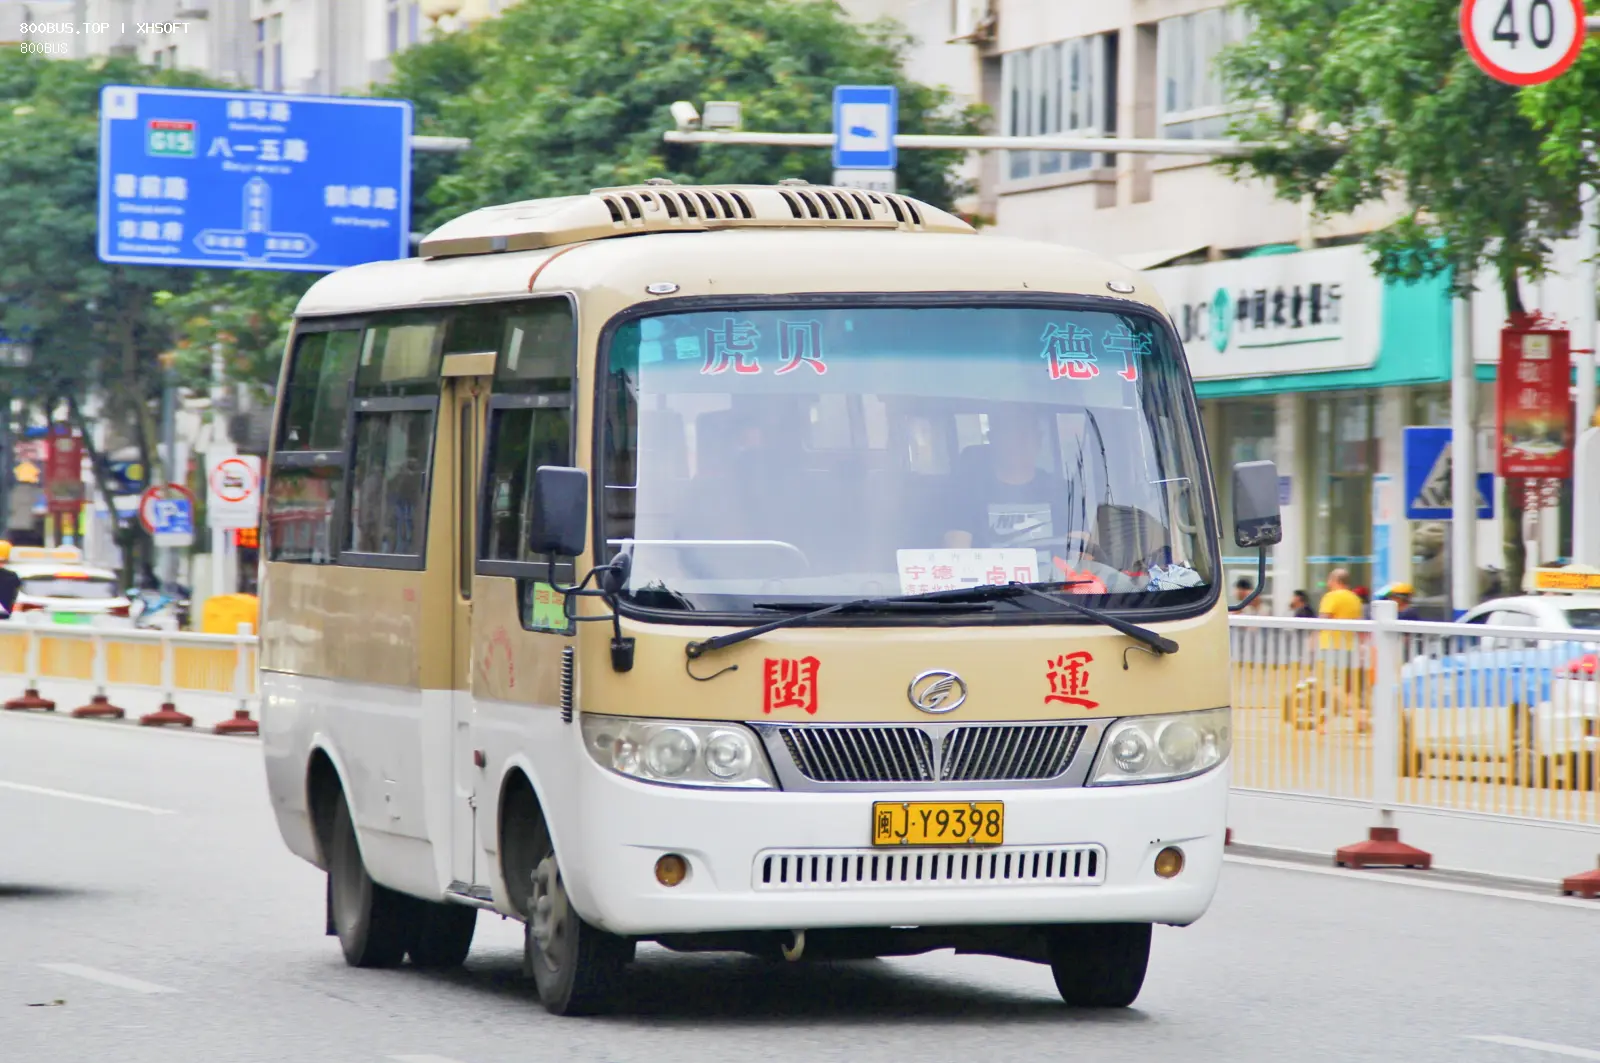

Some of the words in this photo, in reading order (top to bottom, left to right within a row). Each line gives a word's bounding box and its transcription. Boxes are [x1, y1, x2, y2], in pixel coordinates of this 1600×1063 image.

[1492, 0, 1555, 49] 40
[700, 317, 827, 375] 虎贝
[1040, 321, 1153, 381] 德宁
[1044, 650, 1099, 710] 運
